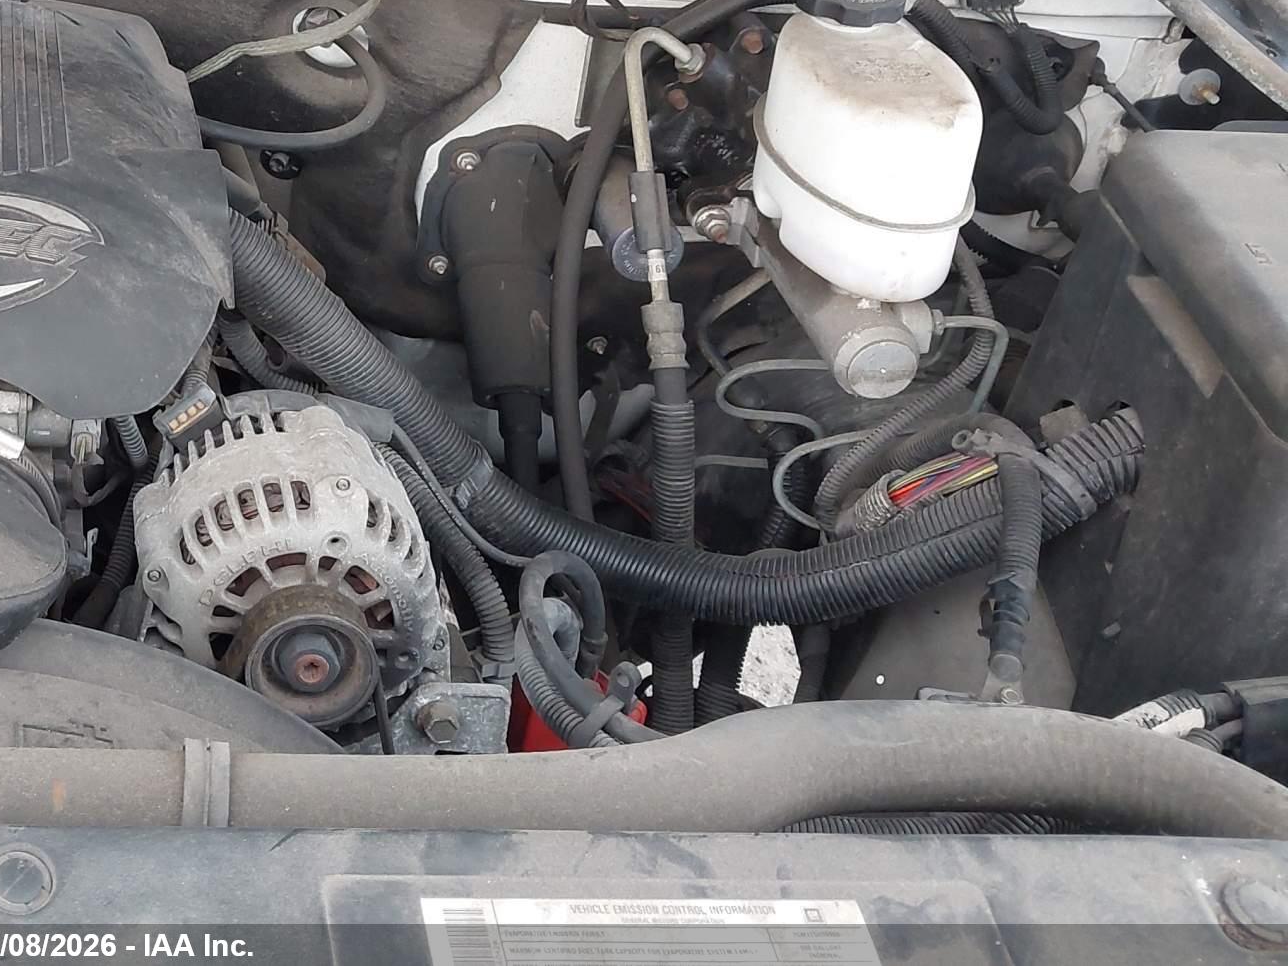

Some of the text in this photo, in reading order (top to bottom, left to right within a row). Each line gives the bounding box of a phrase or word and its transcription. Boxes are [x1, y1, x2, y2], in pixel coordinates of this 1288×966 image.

[569, 904, 776, 915] VEHICLE EMISSION CONTROL INFORMATION
